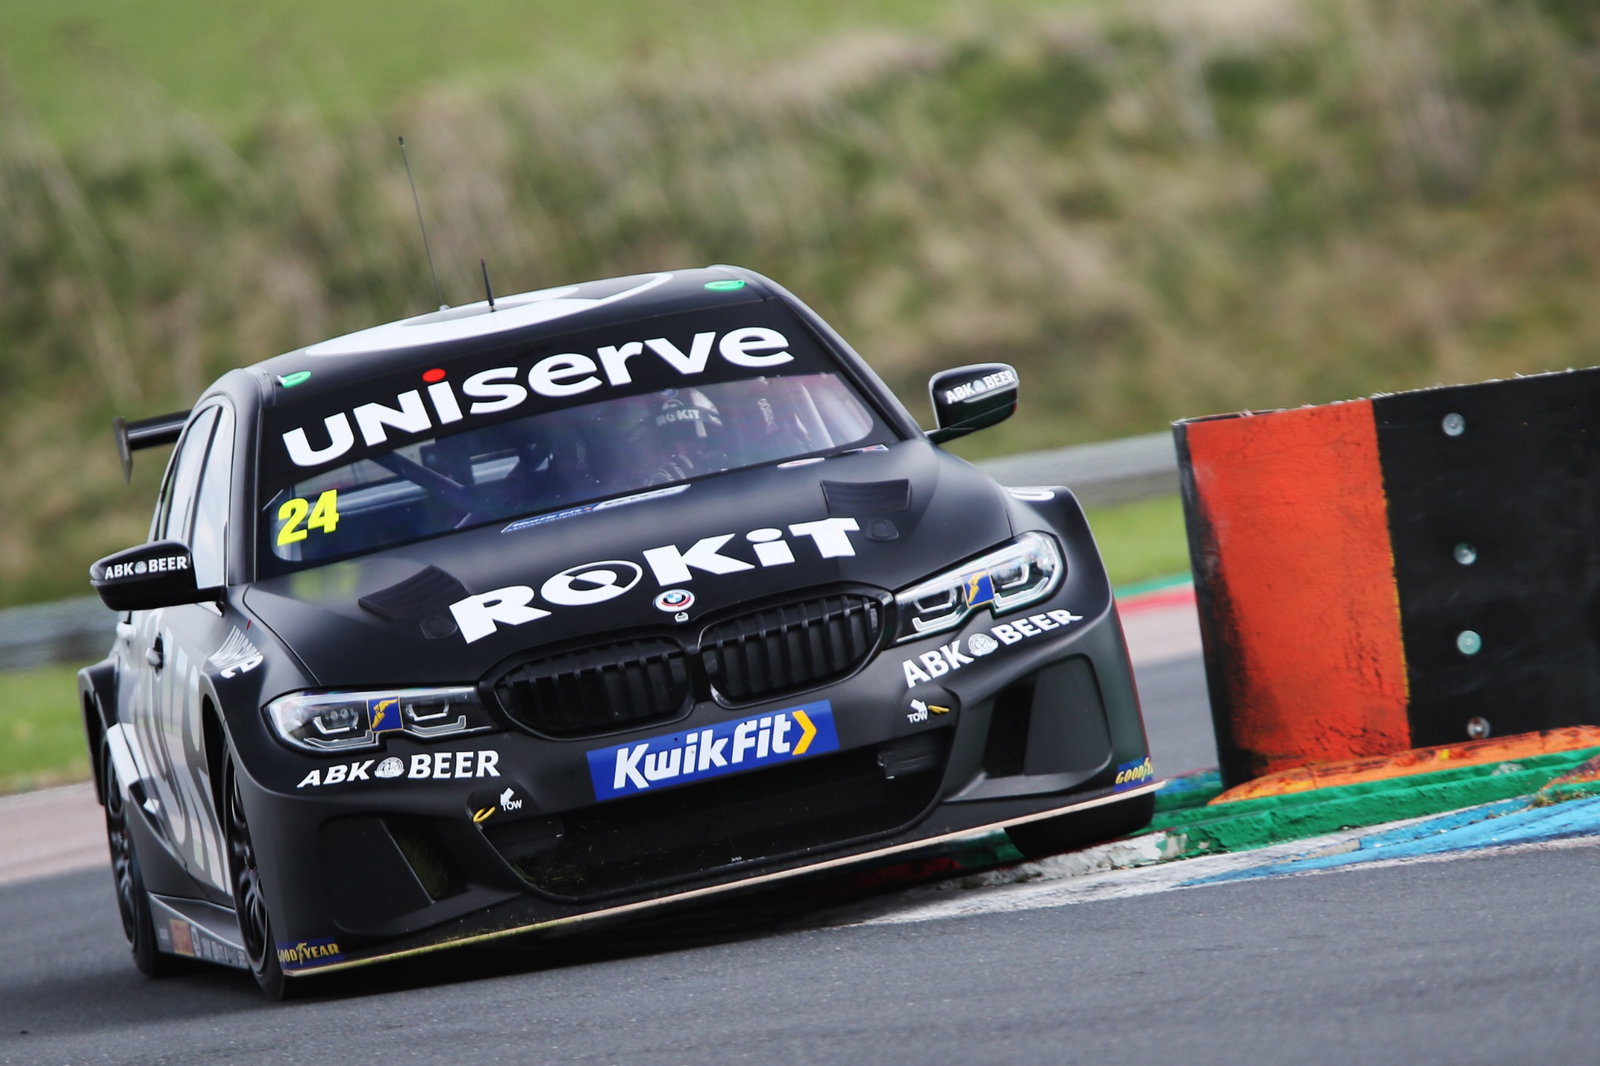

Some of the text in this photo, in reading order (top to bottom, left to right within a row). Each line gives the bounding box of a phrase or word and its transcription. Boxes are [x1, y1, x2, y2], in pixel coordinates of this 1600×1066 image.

[946, 370, 1015, 404] ABK BEER
[277, 489, 340, 546] 24
[105, 556, 188, 580] ABK BEER
[902, 609, 1083, 689] ABK BEER
[907, 710, 929, 723] TOW
[296, 750, 501, 788] ABK BEER
[501, 799, 522, 812] TOW
